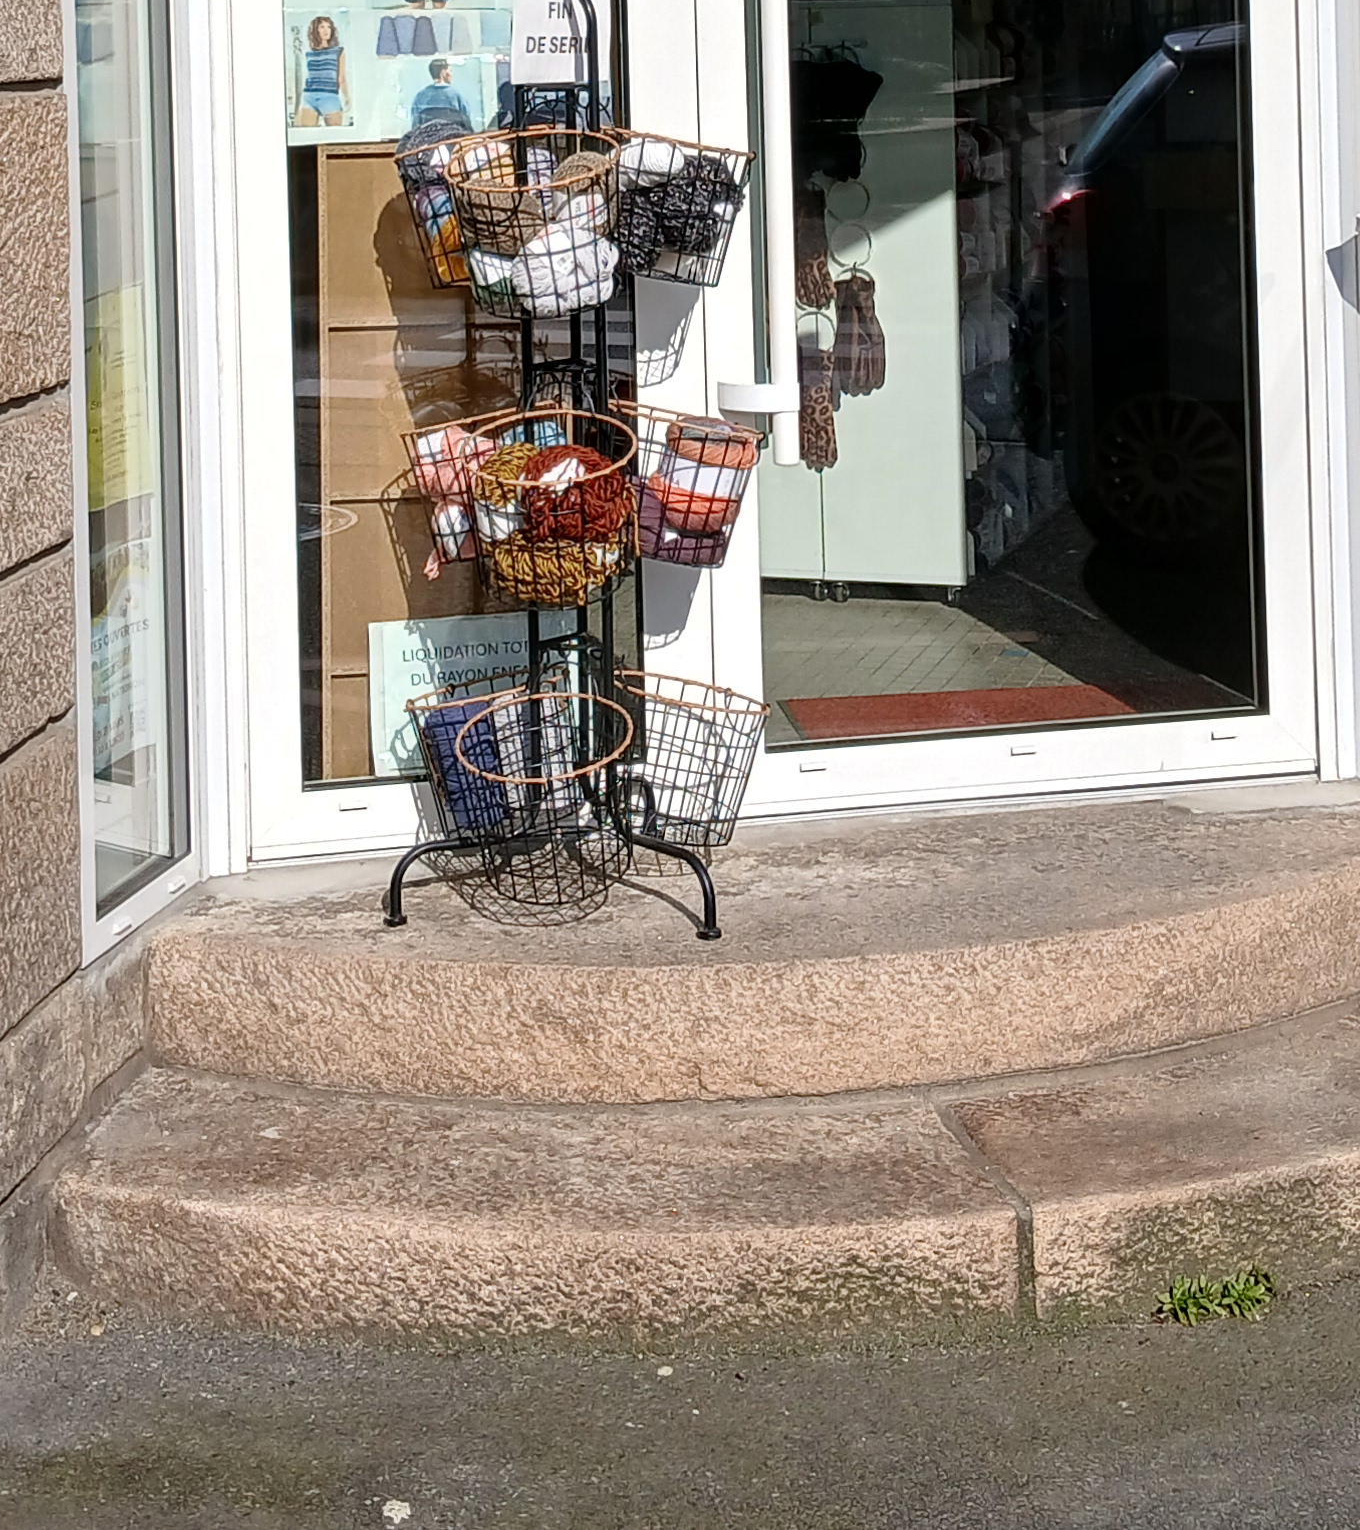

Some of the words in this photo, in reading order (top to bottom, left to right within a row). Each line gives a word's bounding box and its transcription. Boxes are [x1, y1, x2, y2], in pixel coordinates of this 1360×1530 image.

[548, 1, 573, 19] FIN
[526, 36, 546, 54] DE
[402, 641, 499, 662] LIQUIDATION
[502, 640, 529, 654] TOT
[411, 672, 434, 686] DU
[437, 668, 488, 683] RAYON
